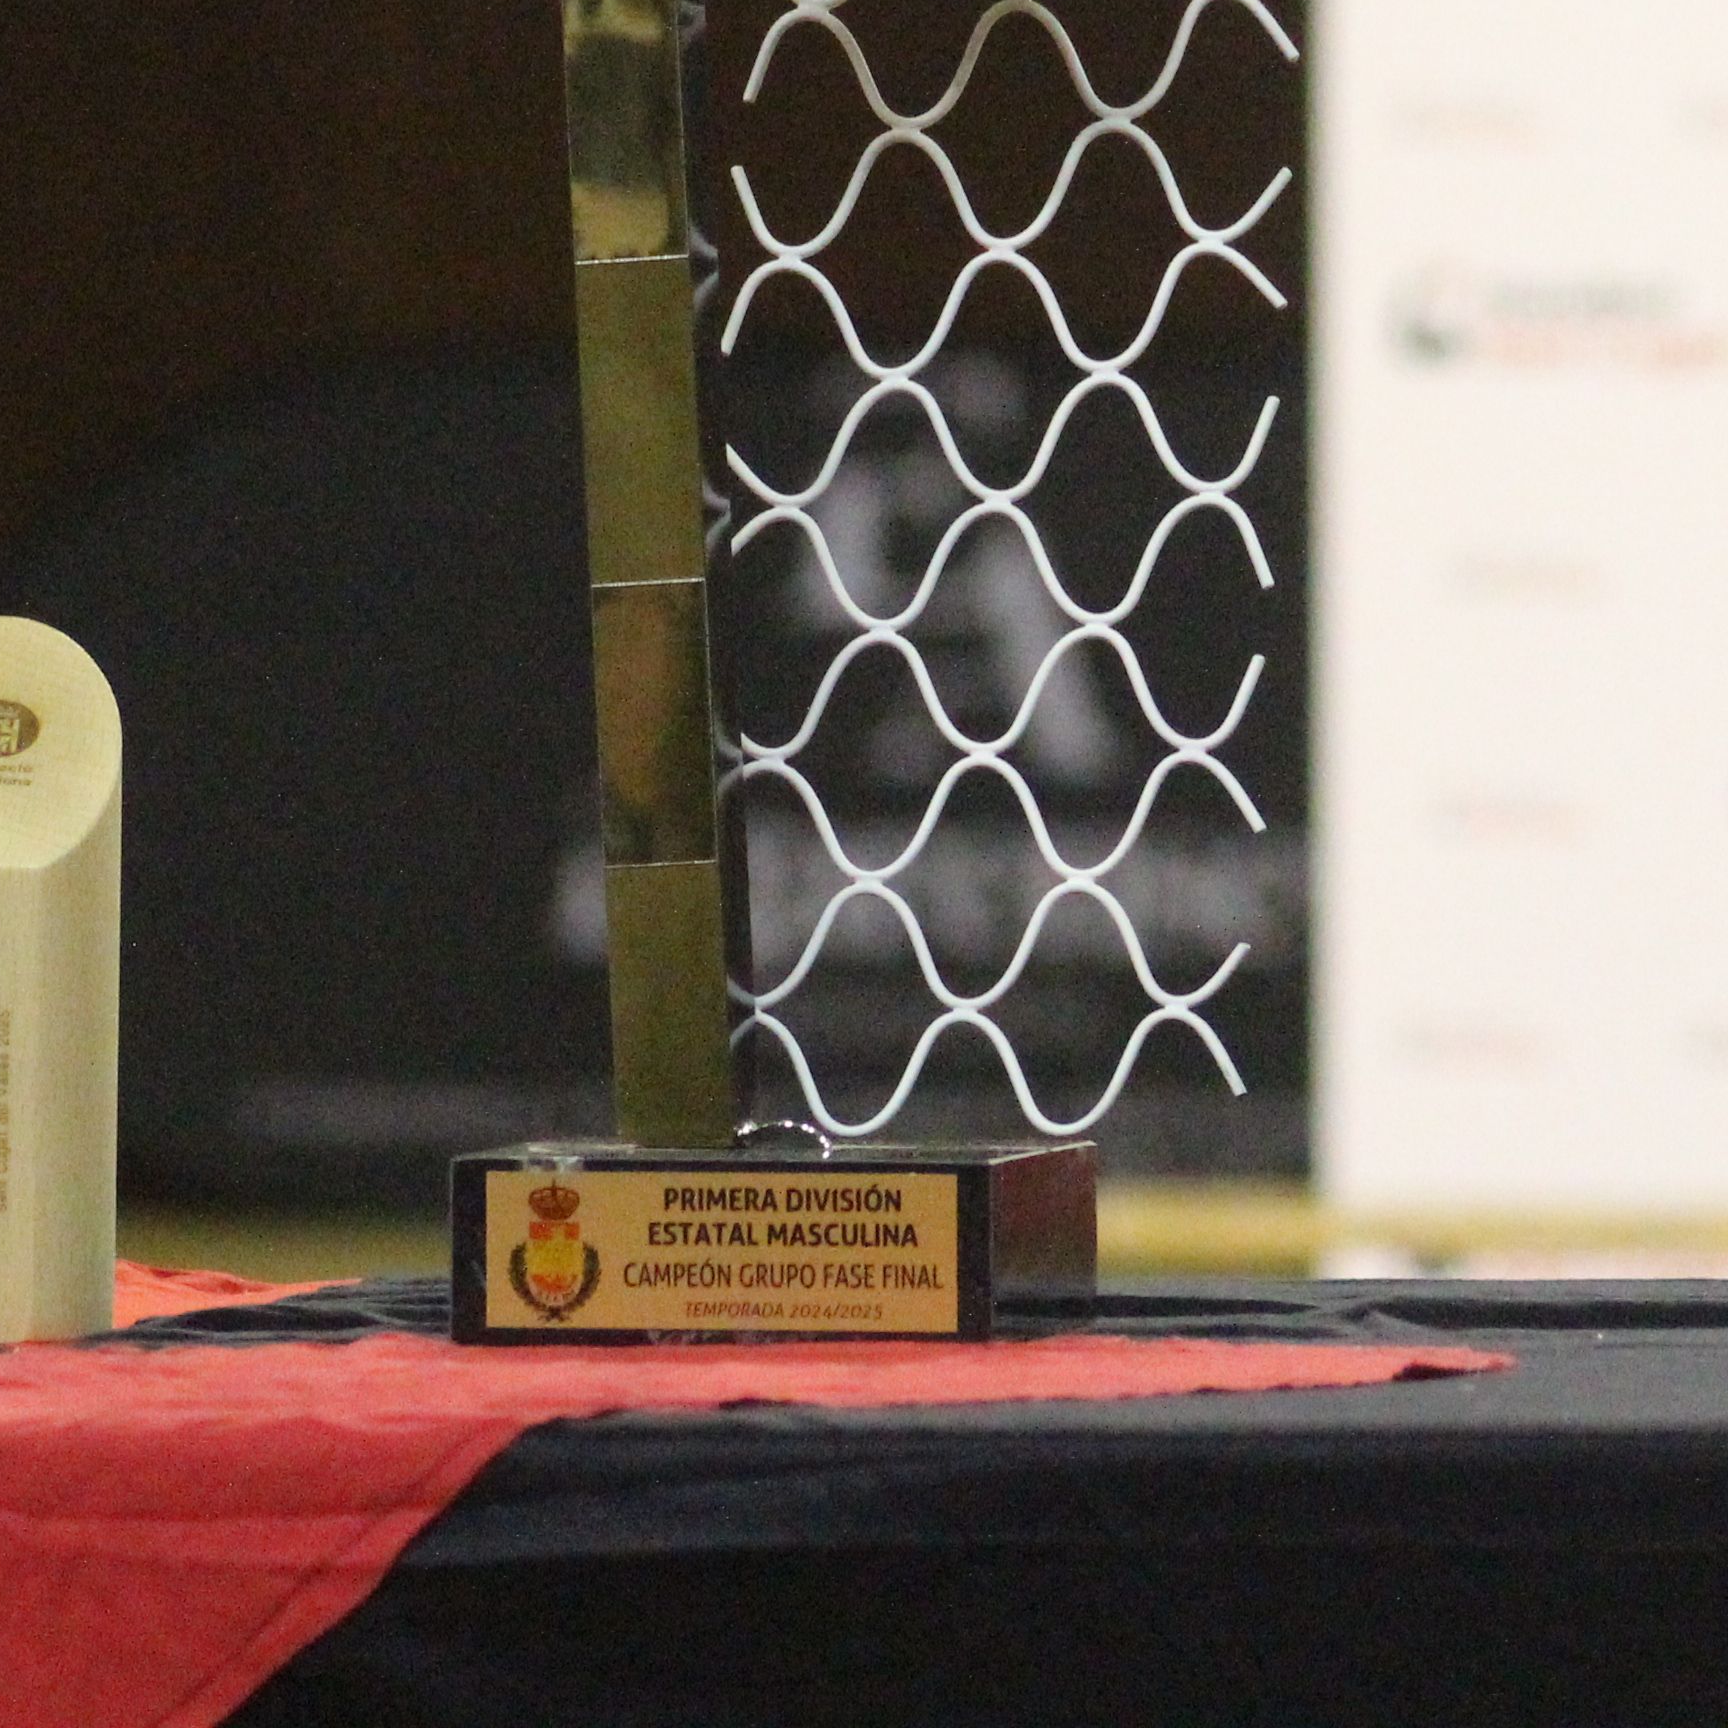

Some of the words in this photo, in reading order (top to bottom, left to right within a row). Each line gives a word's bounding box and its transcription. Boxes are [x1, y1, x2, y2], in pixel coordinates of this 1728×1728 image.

[664, 1187, 778, 1212] PRIMERA
[786, 1184, 902, 1213] DIVISIÓN
[648, 1222, 759, 1247] ESTATAL
[767, 1222, 919, 1248] MASCULINA
[623, 1257, 732, 1289] CAMPEÓN
[738, 1262, 817, 1289] GRUPO
[823, 1263, 876, 1290] FASE
[882, 1263, 945, 1290] FINAL
[685, 1301, 785, 1319] TEMPORADA
[788, 1302, 884, 1321] 2024/2025
